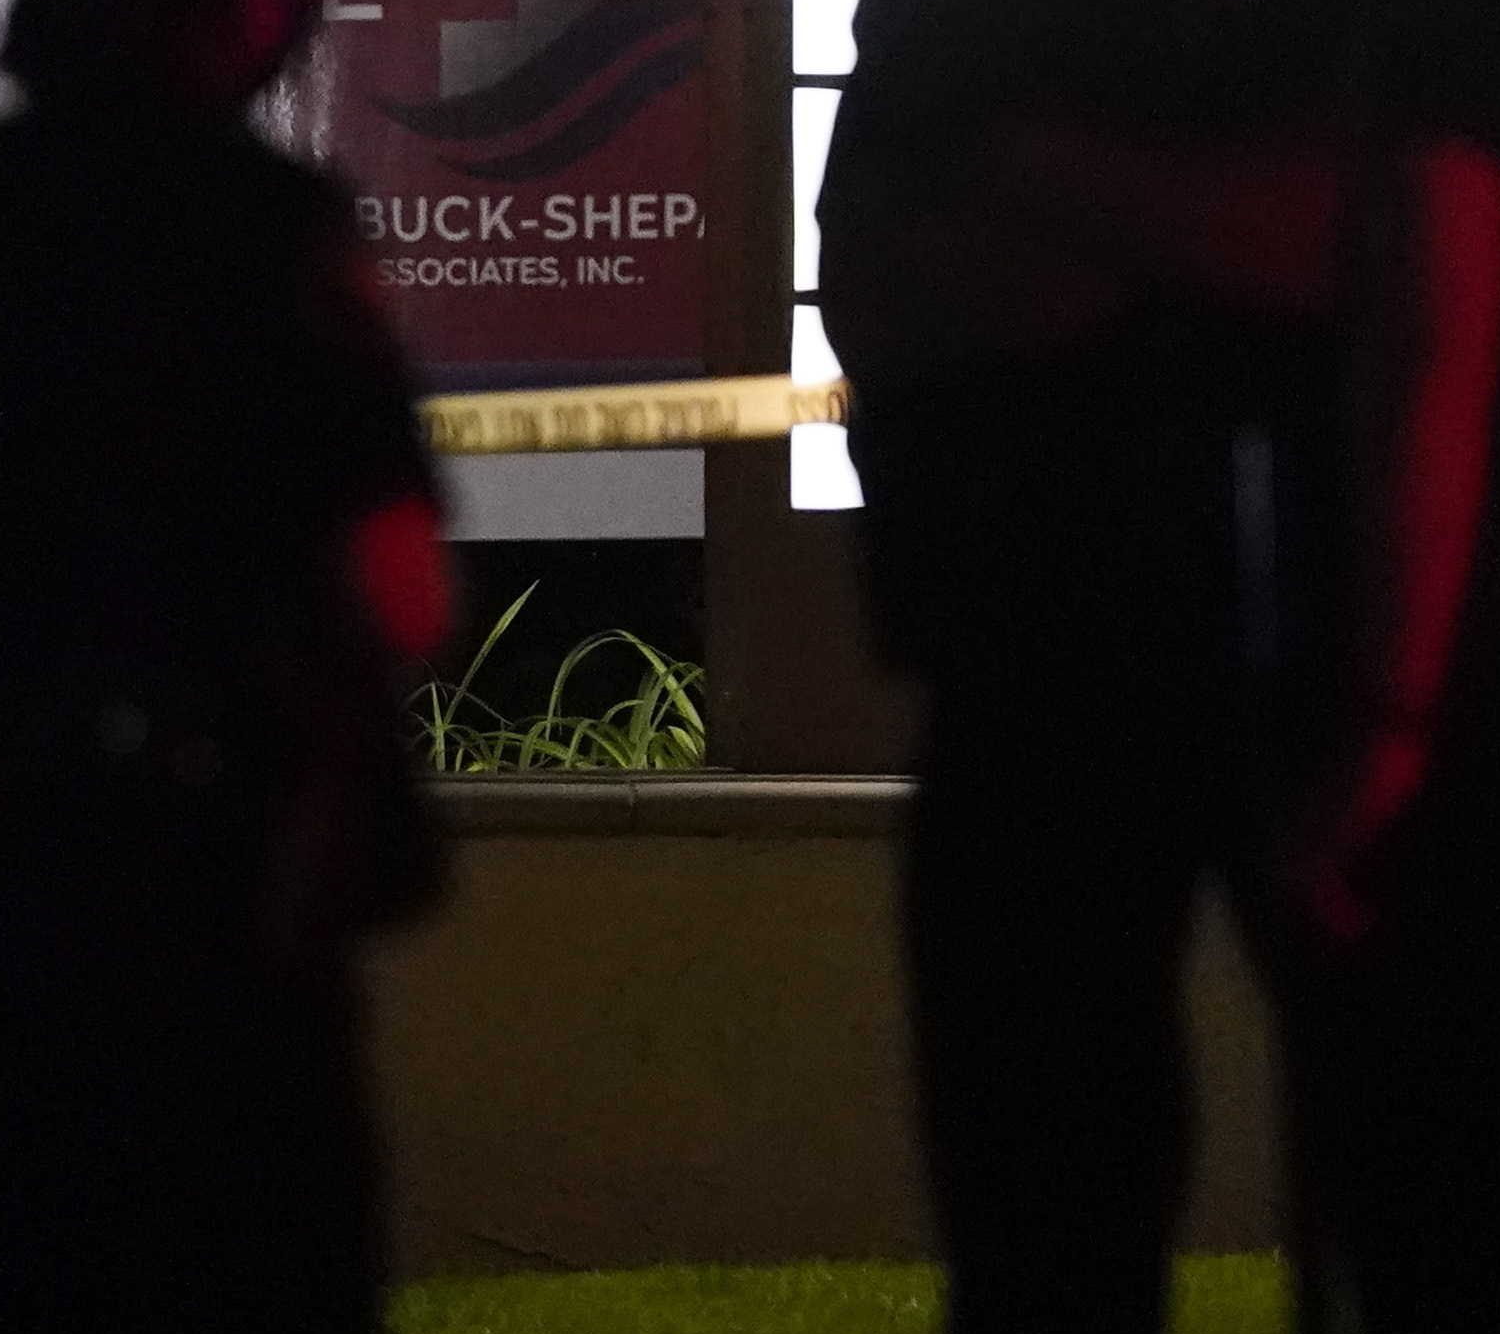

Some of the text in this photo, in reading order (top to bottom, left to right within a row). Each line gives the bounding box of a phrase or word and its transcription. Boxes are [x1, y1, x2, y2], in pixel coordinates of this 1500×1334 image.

[353, 193, 706, 243] BUCK-SHEP
[376, 255, 646, 289] SSOCIATES, INC.
